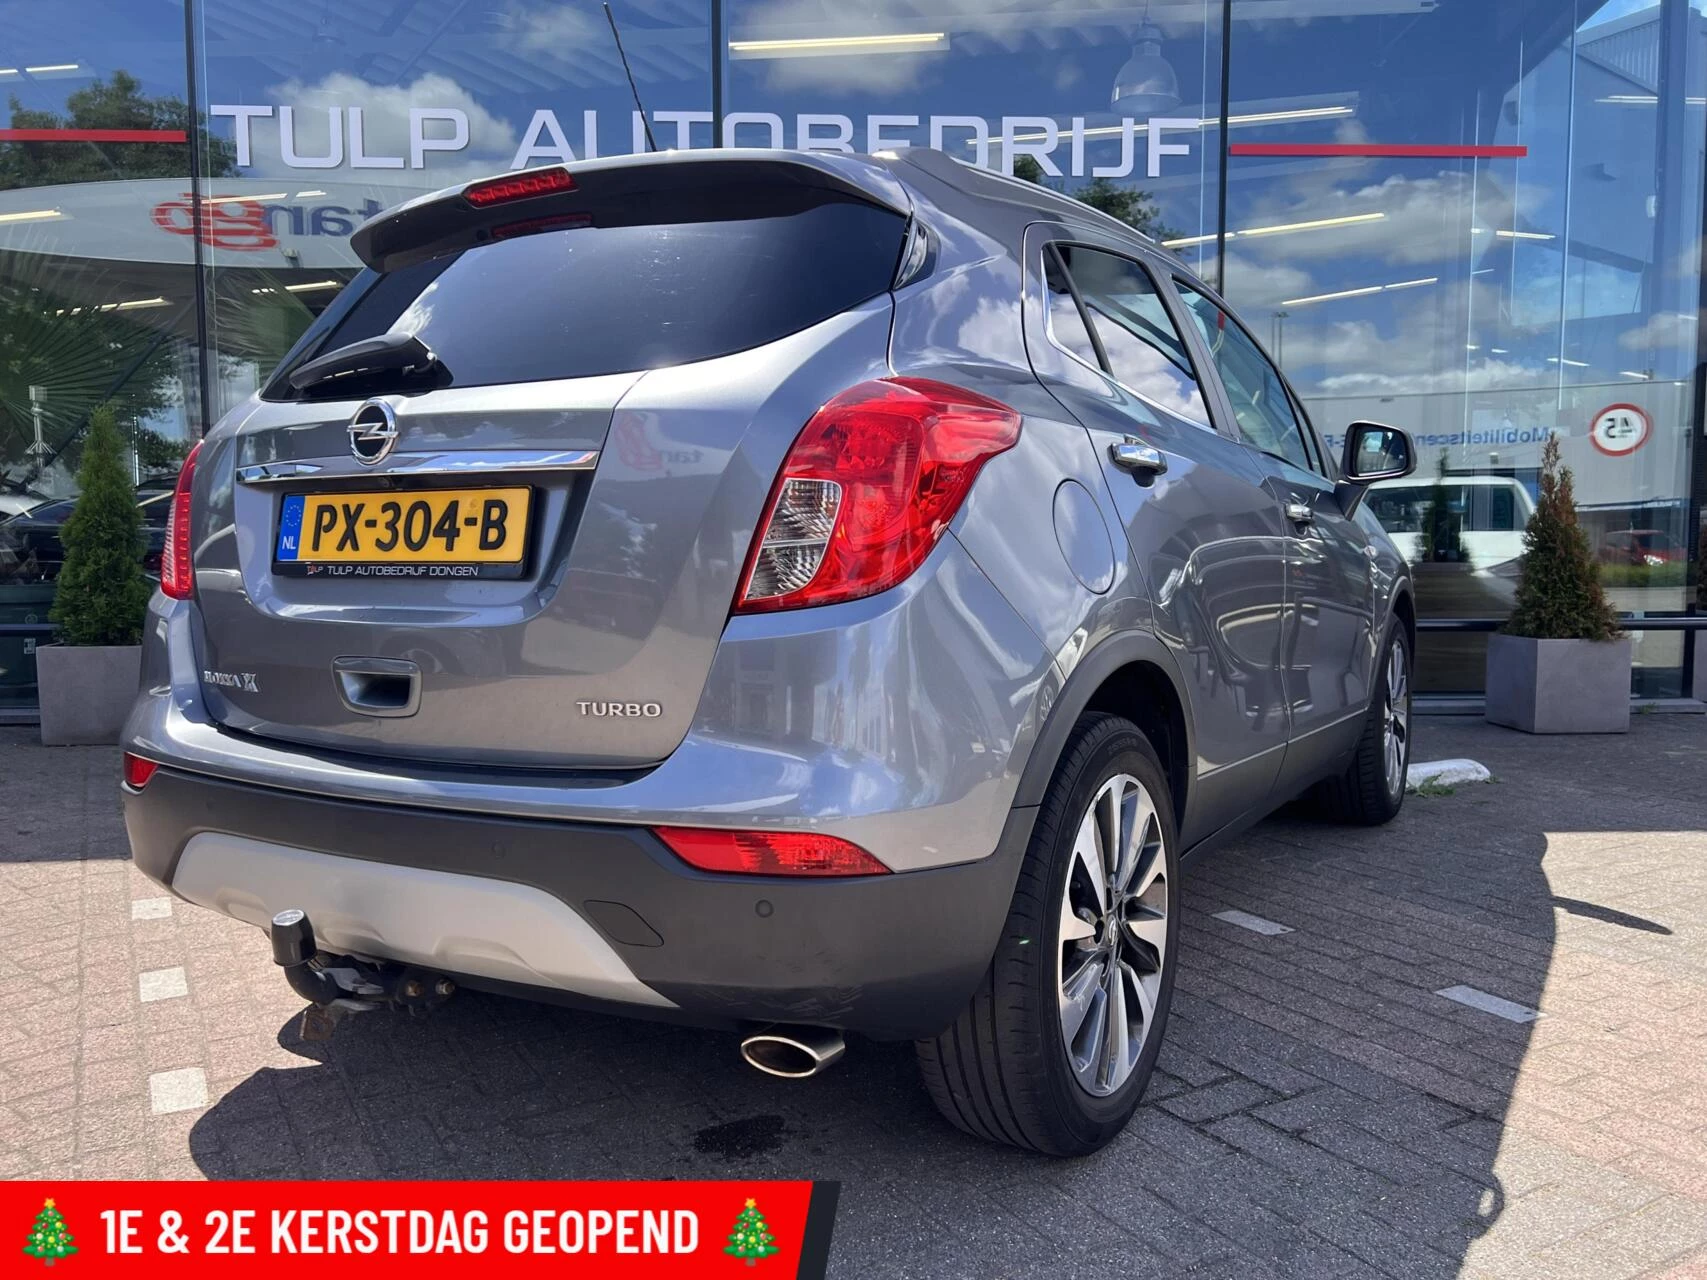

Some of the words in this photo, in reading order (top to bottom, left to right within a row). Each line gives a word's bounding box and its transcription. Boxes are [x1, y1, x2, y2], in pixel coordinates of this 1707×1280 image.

[210, 104, 470, 169] TULP
[510, 109, 1200, 178] AUTOBEDRIJF
[311, 499, 509, 552] PX-304-B
[281, 535, 297, 551] NL
[327, 565, 353, 575] TULP
[354, 565, 427, 576] AUTOBEDRIJF
[429, 566, 479, 577] DONGEN
[576, 701, 662, 718] TURBO
